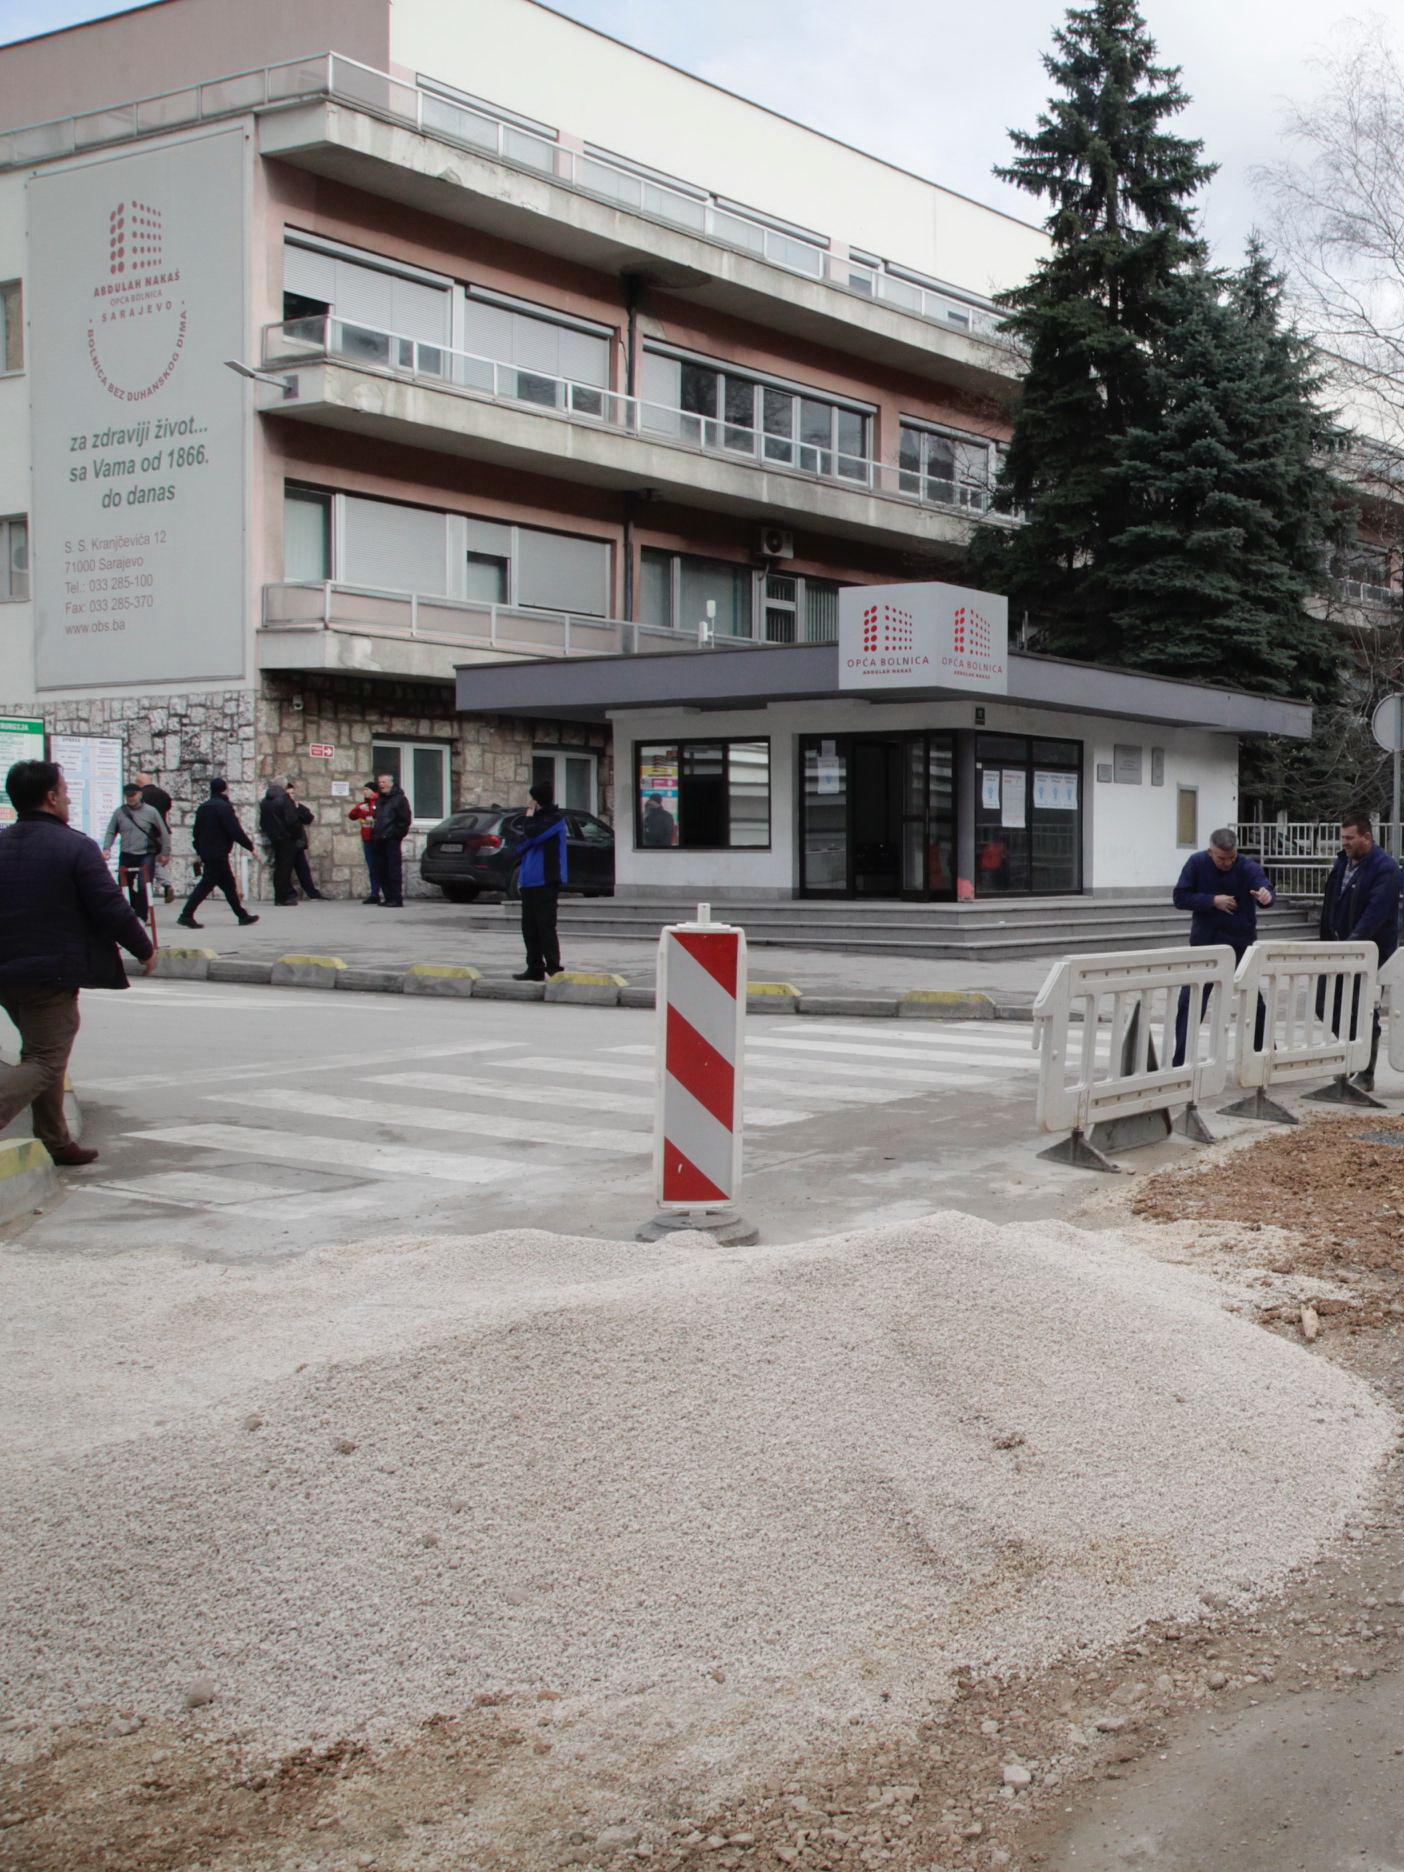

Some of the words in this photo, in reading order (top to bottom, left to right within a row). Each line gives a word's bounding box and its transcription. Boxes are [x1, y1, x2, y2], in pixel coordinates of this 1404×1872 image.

[94, 279, 141, 297] ABDULAH
[145, 268, 180, 287] NAKAŠ
[130, 288, 163, 303] BOLNICA
[102, 300, 172, 322] SARAJEVO
[88, 328, 108, 386] BOLNICA
[107, 382, 126, 400] BEZ
[126, 352, 180, 401] DUHANSKOG
[176, 310, 188, 348] DIMA
[70, 434, 87, 452] za
[92, 421, 150, 448] zdraviji
[154, 416, 208, 440] život...
[69, 465, 88, 482] sa
[92, 458, 136, 480] Vama
[141, 450, 162, 473] od
[168, 444, 209, 469] 1866.
[102, 488, 122, 508] do
[126, 484, 176, 506] danas
[154, 530, 167, 544] 12
[65, 560, 96, 574] 71000
[98, 556, 144, 572] Sarajevo
[89, 579, 108, 592] 033
[111, 574, 154, 590] 285-100
[89, 599, 109, 614] 033
[111, 594, 154, 612] 285-370
[64, 620, 126, 635] www.obs.ba
[847, 657, 876, 668] OPĆA
[880, 656, 930, 666] BOLNICA
[966, 661, 1003, 674] BOLNICA
